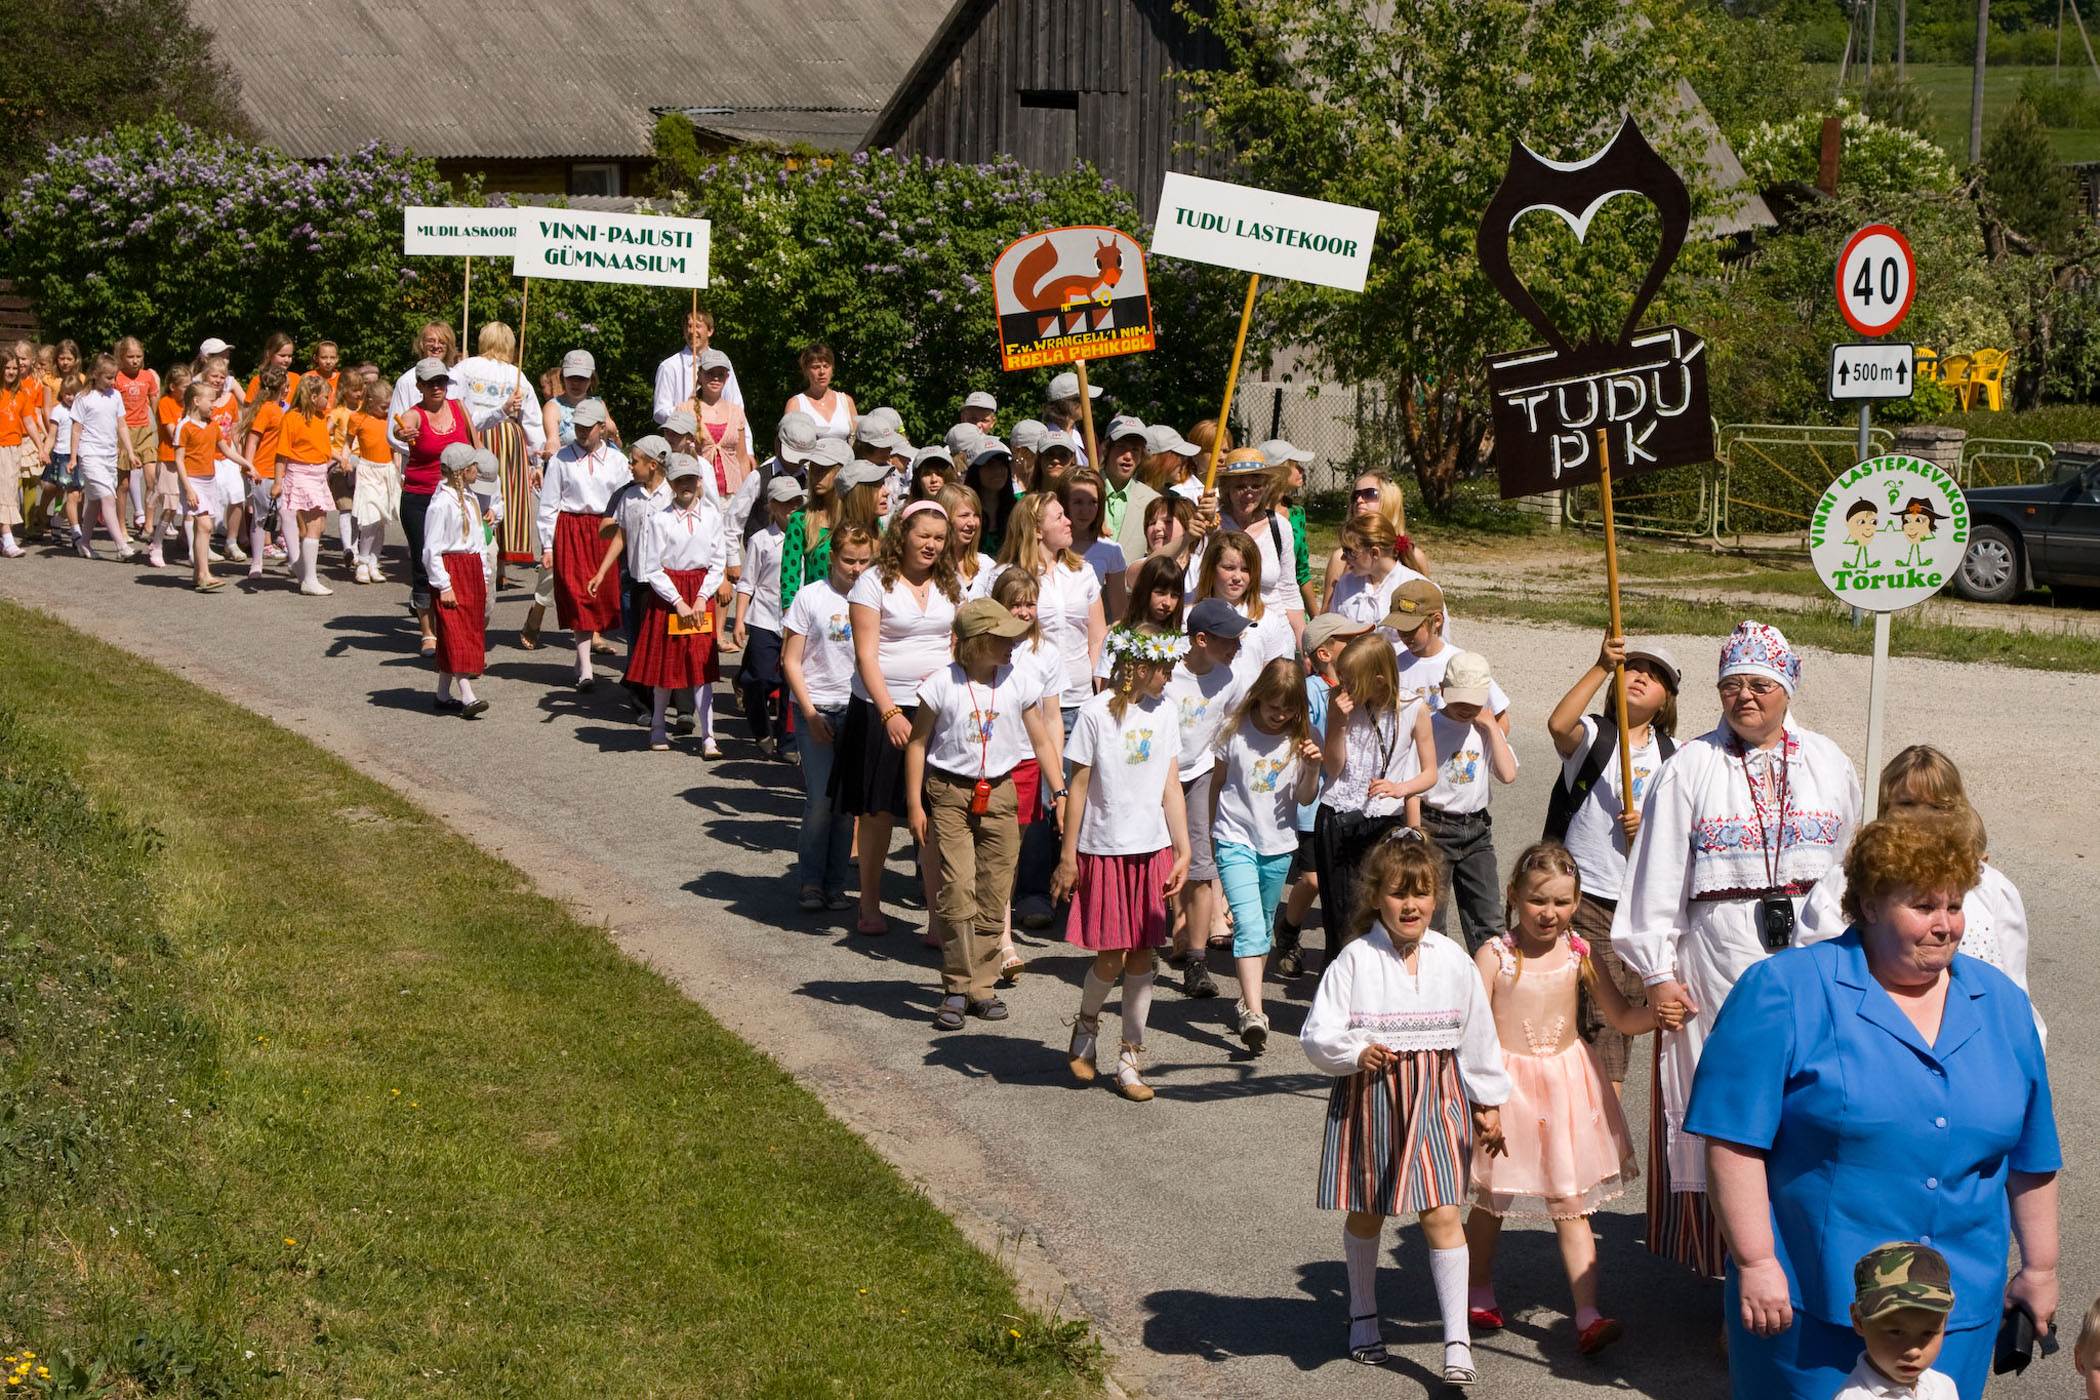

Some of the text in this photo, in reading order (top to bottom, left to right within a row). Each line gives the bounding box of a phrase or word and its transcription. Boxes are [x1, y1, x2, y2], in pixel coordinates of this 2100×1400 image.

[417, 225, 518, 238] MUDILASKOOR
[539, 221, 693, 248] VINNI-PAJUSTI
[1175, 206, 1358, 258] TUDU LASTEKOOR
[544, 245, 686, 274] GÜMNAASIUM
[1853, 256, 1899, 306] 40
[1120, 324, 1150, 339] NIM.
[1007, 336, 1151, 369] ROELA PÕHIKOOL
[1853, 363, 1893, 381] 500 m
[1508, 363, 1691, 434] TUDU
[1811, 492, 1838, 549] VINNI
[1831, 568, 1943, 591] Tõruke
